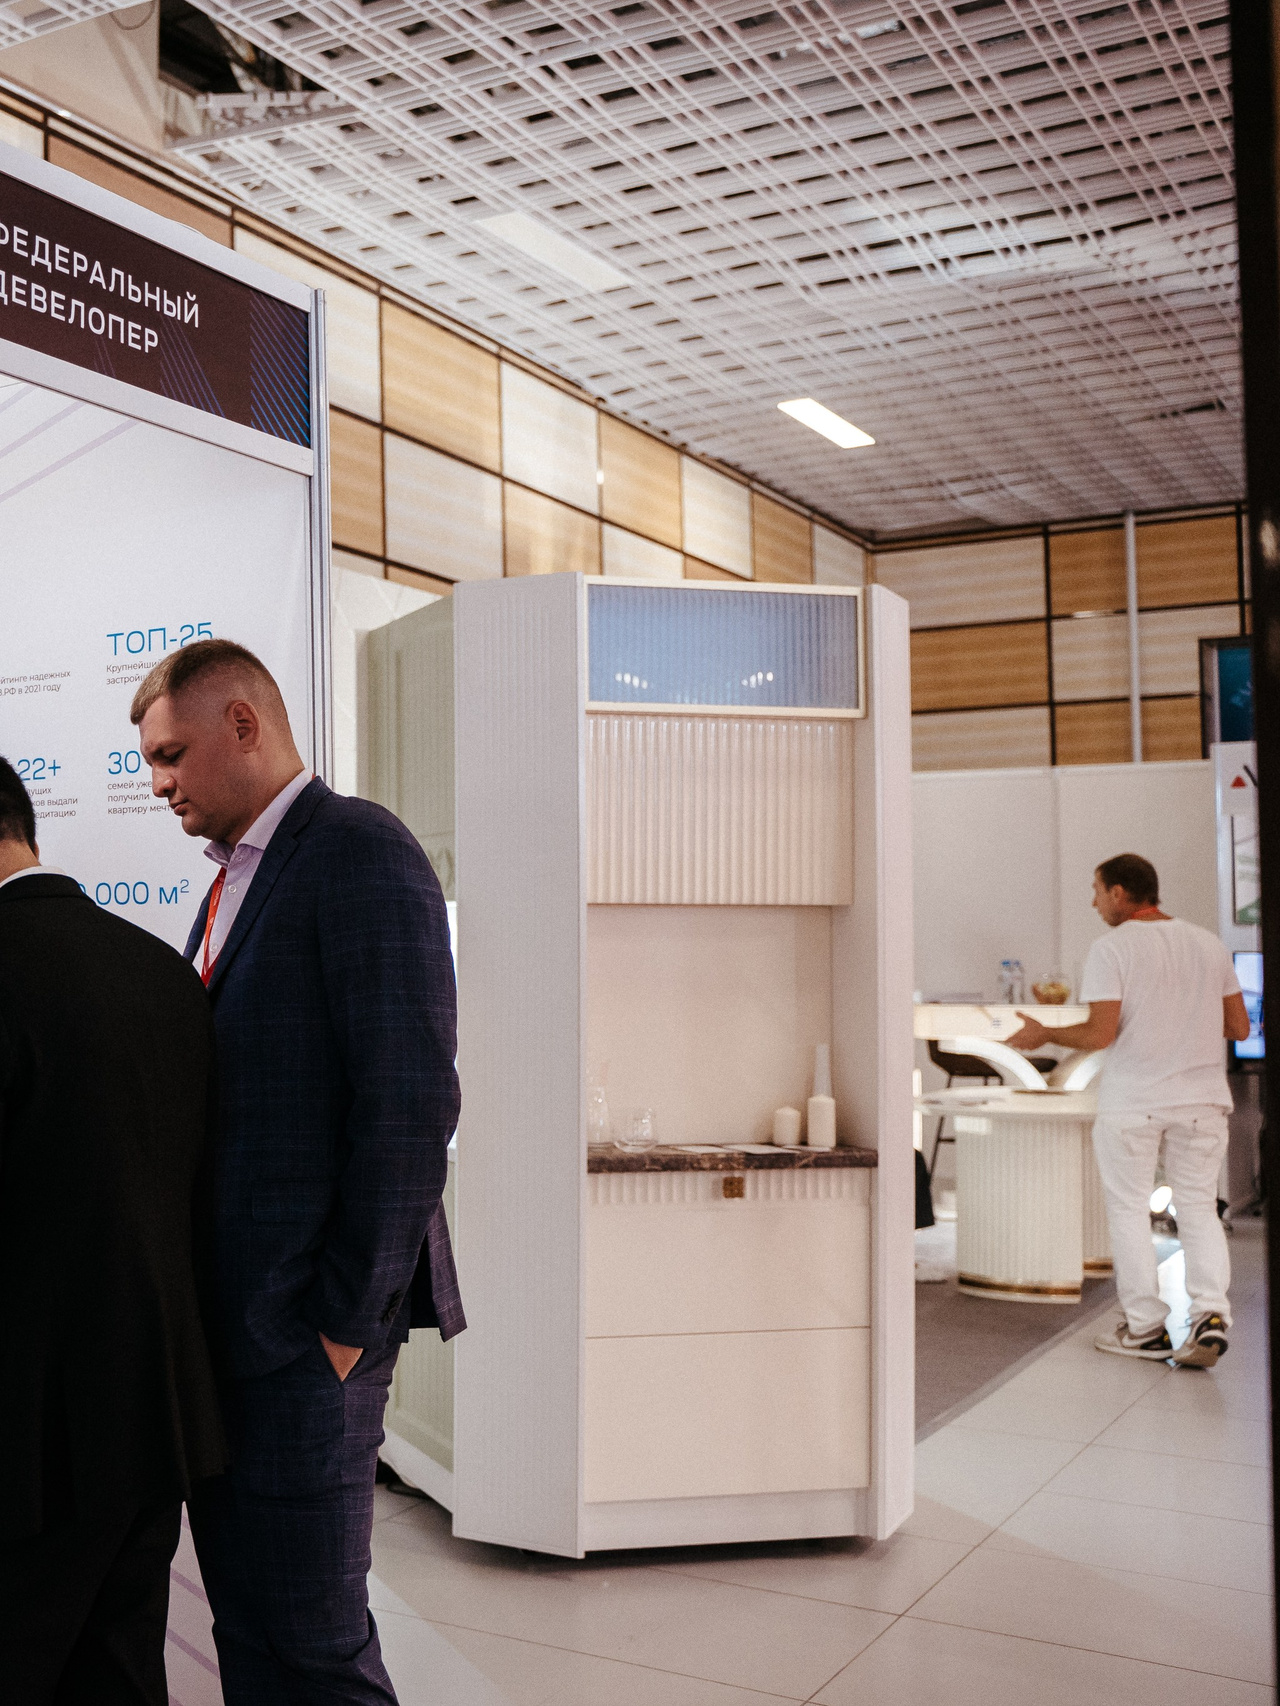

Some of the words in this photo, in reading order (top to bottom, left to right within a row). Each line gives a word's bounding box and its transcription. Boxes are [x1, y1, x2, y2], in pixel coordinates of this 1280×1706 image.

[106, 622, 213, 656] ТОП-25
[29, 671, 70, 681] надежных
[24, 685, 41, 693] 2021
[42, 683, 62, 692] году
[108, 750, 141, 775] 30
[17, 757, 61, 781] 22+
[107, 781, 134, 790] семей
[136, 780, 152, 790] уже
[26, 787, 52, 797] дущих
[32, 799, 45, 807] ков
[47, 798, 78, 806] выдали
[107, 793, 150, 803] получили
[35, 810, 76, 819] едитацию
[107, 806, 147, 815] квартиру
